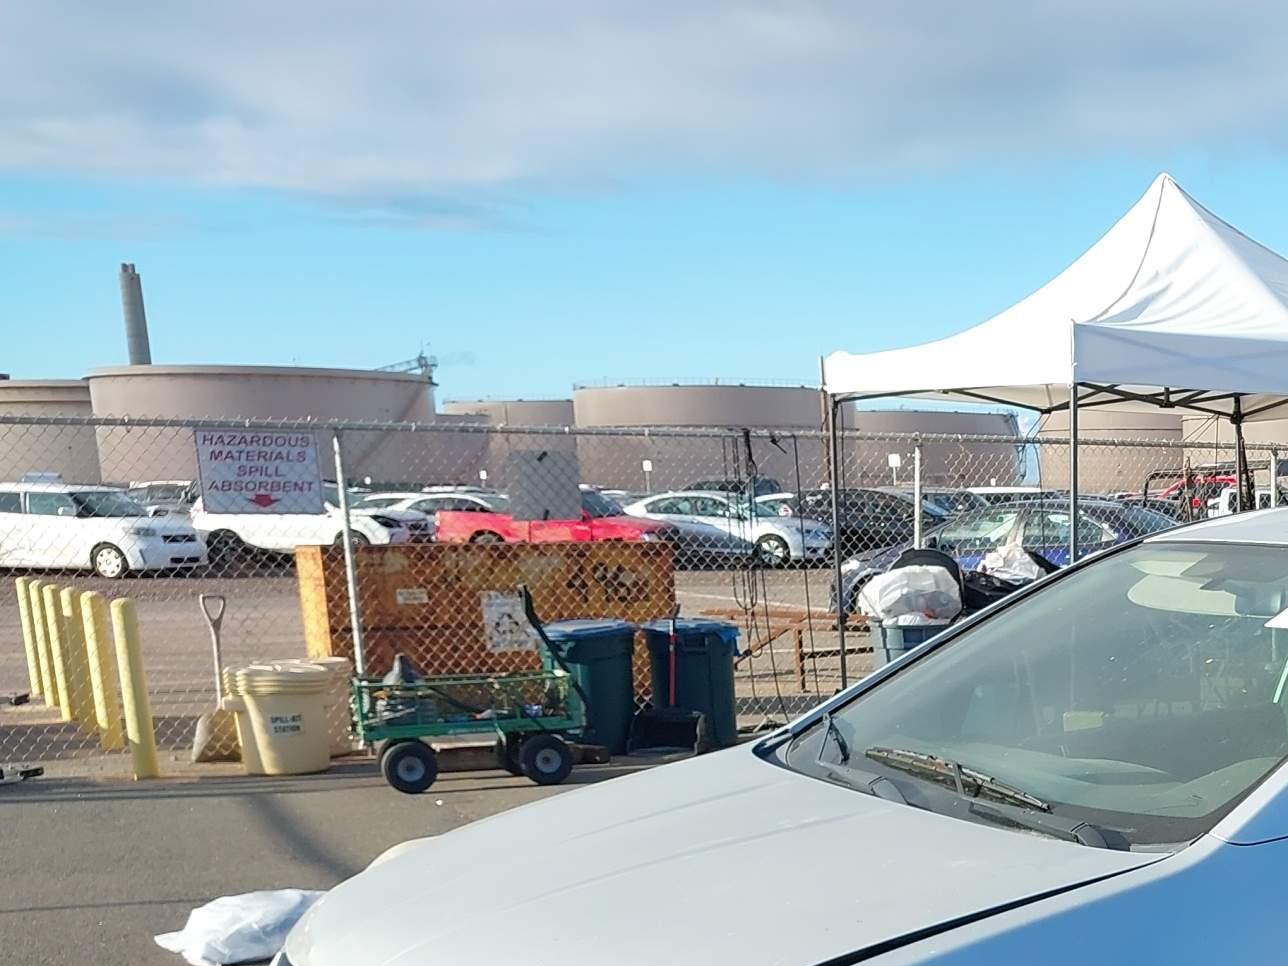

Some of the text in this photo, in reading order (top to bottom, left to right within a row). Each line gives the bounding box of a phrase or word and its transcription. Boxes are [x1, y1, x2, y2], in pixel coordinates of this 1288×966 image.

[202, 434, 310, 448] HAZARDOUS
[209, 449, 306, 463] MATERIALS
[236, 464, 286, 478] SPILL
[208, 480, 313, 493] ABSORBENT
